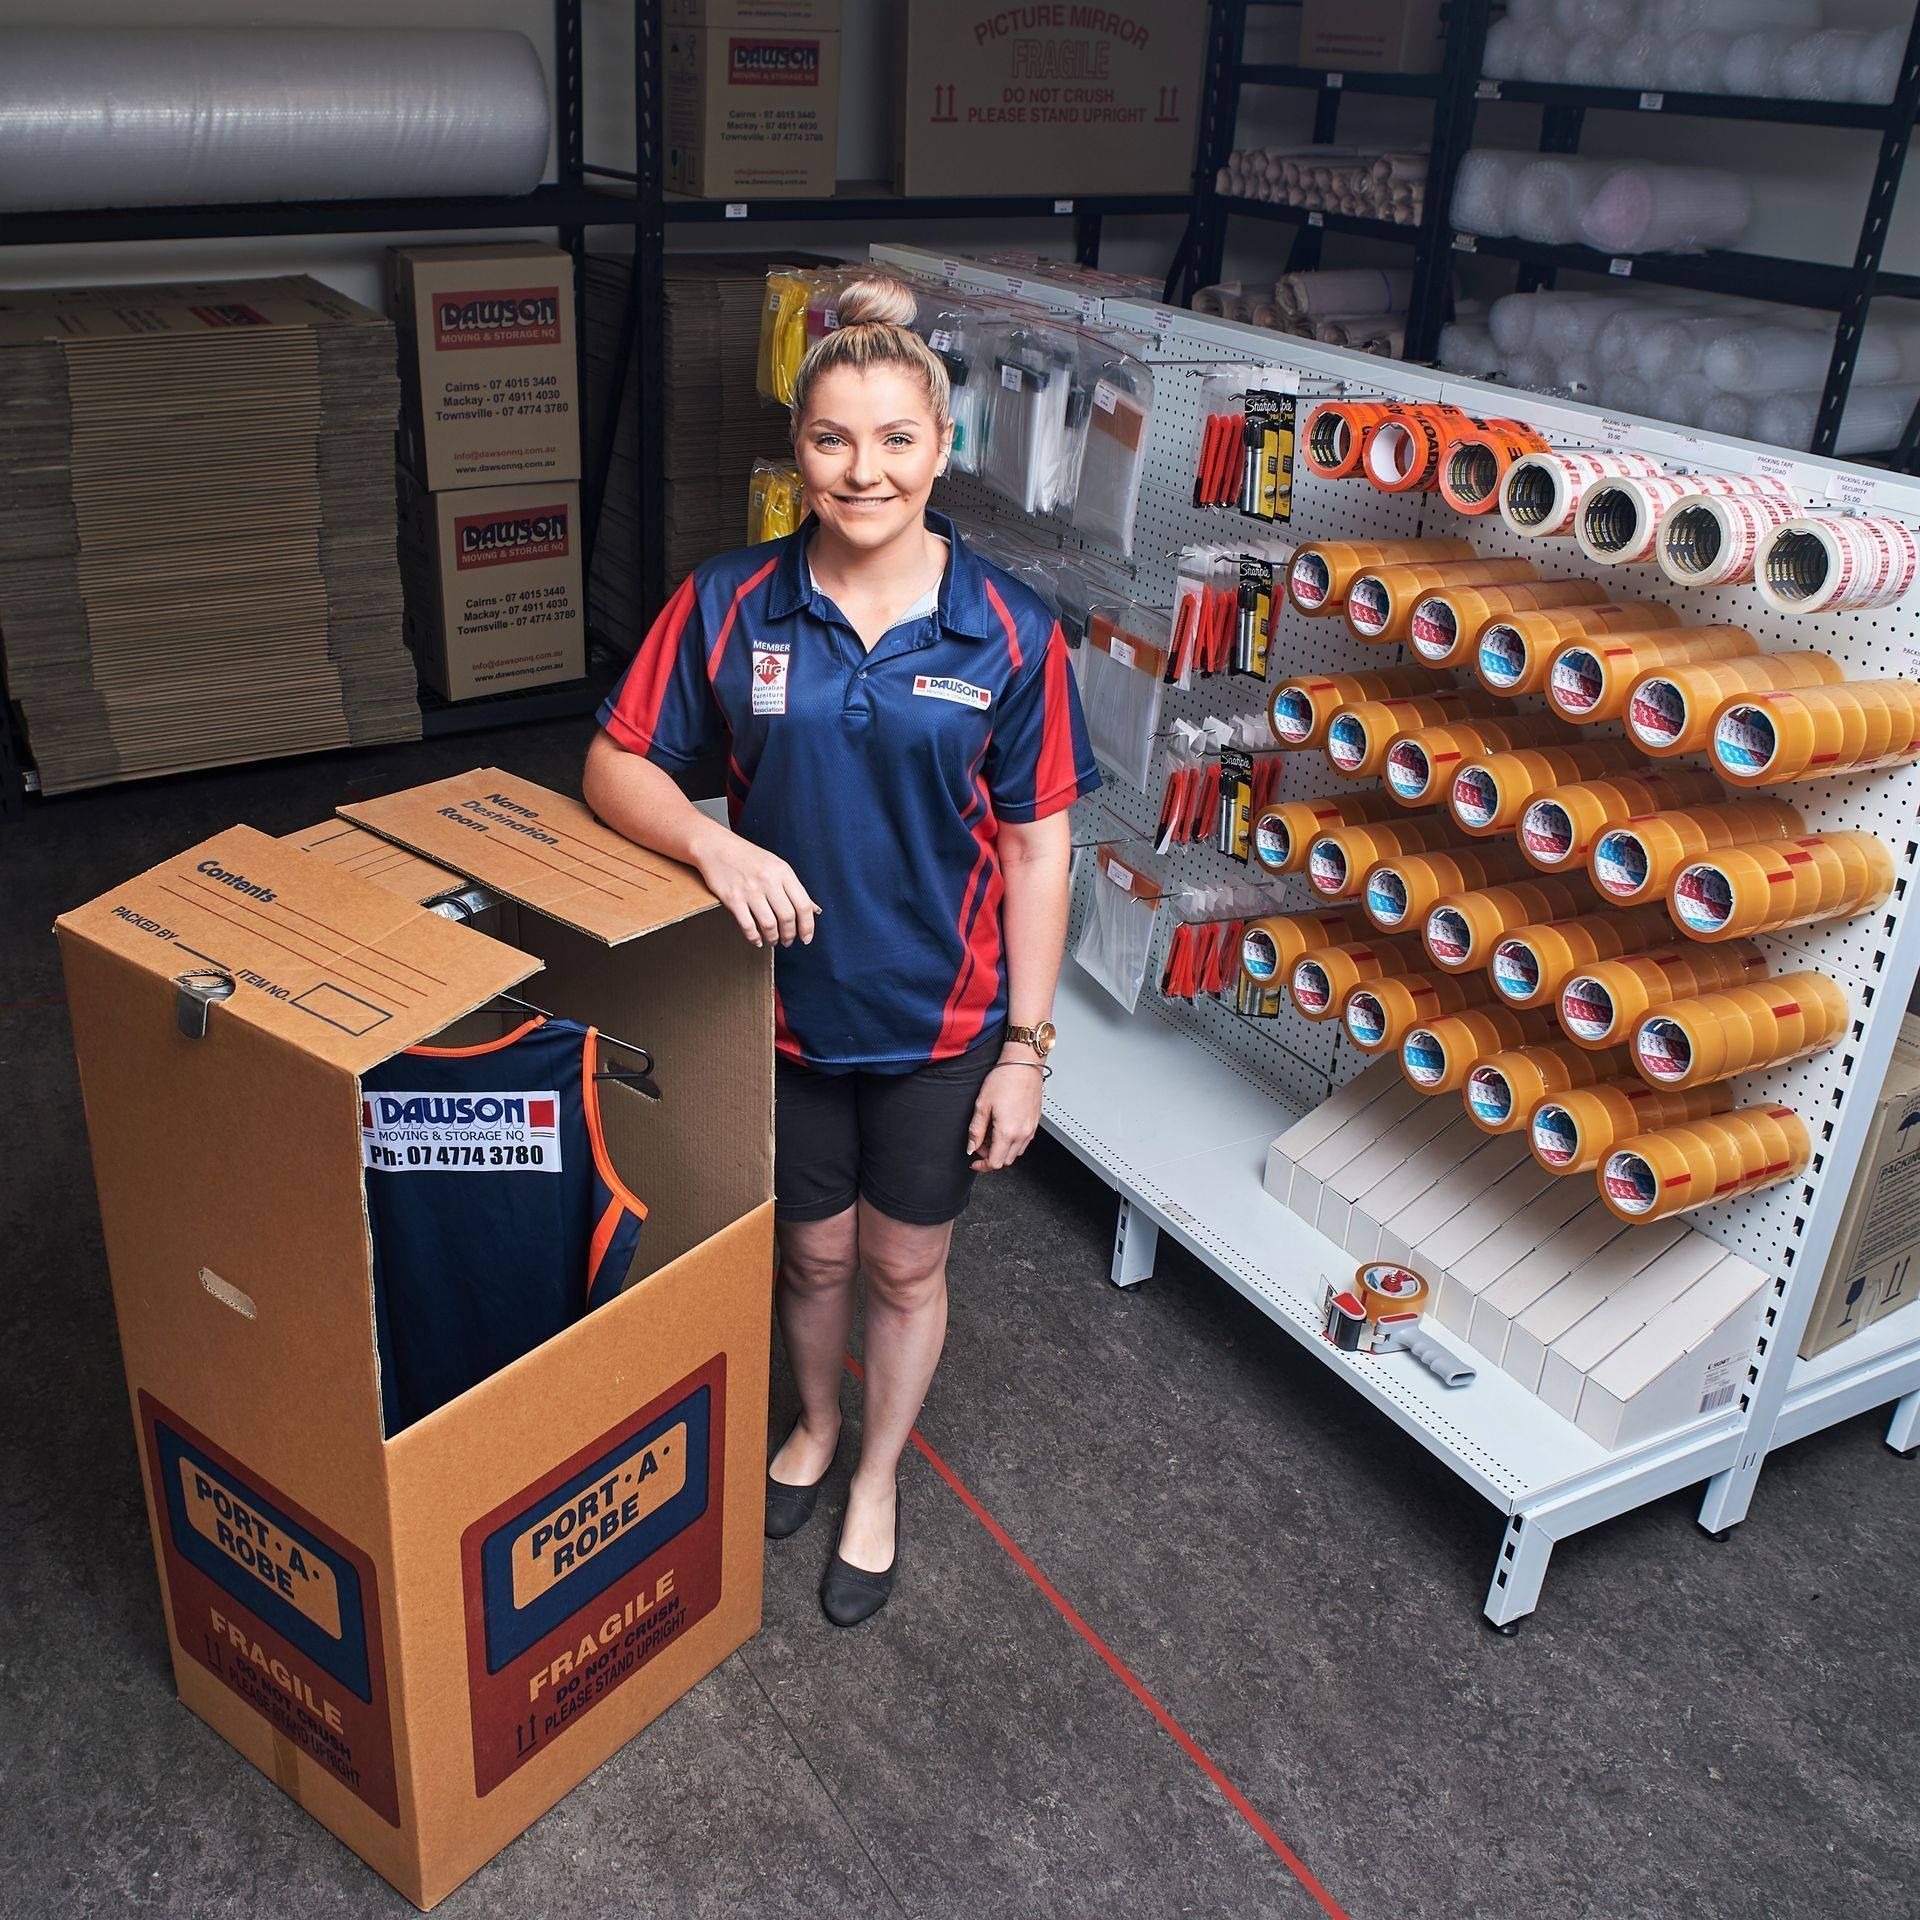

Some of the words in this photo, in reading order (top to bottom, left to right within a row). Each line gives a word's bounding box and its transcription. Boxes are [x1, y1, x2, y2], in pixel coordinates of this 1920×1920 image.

[973, 4, 1066, 47] PICTURE
[1069, 4, 1151, 51] MIRROR
[735, 46, 818, 70] DAWSON
[1011, 38, 1112, 81] FRAGILE
[1003, 87, 1026, 103] DO
[1029, 87, 1060, 103] NOT
[1063, 87, 1115, 103] CRUSH
[967, 107, 1026, 123] PLEASE
[1030, 107, 1079, 123] STAND
[1082, 107, 1148, 123] UPRIGHT
[440, 297, 557, 332] DAWSON
[441, 332, 481, 344] MOVING
[484, 332, 491, 341] &
[494, 329, 540, 341] STORAGE
[541, 327, 556, 339] NQ
[445, 380, 480, 393] Cairns
[489, 379, 502, 390] 07
[504, 378, 530, 389] 4015
[532, 376, 557, 387] 3440
[443, 394, 484, 408] Mackay
[493, 393, 505, 404] 07
[508, 391, 533, 403] 4911
[535, 389, 561, 400] 4030
[435, 407, 493, 421] Townsville
[502, 406, 514, 417] 07
[517, 404, 542, 416] 4774
[544, 402, 569, 414] 3780
[455, 458, 556, 474] www.dawsonnq.com.au
[1757, 456, 1780, 466] PACKING
[1781, 460, 1794, 468] TAPE
[1836, 474, 1861, 484] PACKING
[1862, 480, 1876, 488] TAPE
[1841, 484, 1867, 494] SECURITY
[461, 515, 567, 553] DAWSON
[462, 551, 498, 564] MOVING
[500, 550, 507, 558] &
[509, 544, 549, 557] STORAGE
[551, 542, 564, 552] NQ
[464, 608, 500, 622] Mackay
[508, 605, 520, 615] 07
[522, 602, 544, 613] 4911
[546, 598, 568, 609] 4030
[465, 596, 497, 609] Cairns
[505, 593, 517, 603] 07
[519, 589, 541, 601] 4015
[543, 586, 566, 597] 3440
[456, 620, 508, 636] Townsville
[516, 616, 527, 626] 07
[529, 613, 552, 625] 4774
[553, 609, 576, 621] 3780
[753, 640, 791, 652] MEMBER
[475, 663, 564, 682] www.dawsonnq.com.au
[754, 658, 783, 676] afra
[930, 679, 979, 698] DAWSON
[483, 793, 540, 819] Name
[436, 807, 490, 833] Room
[460, 800, 559, 846] Destination
[196, 860, 279, 903] Contents
[111, 906, 161, 934] PACKED
[154, 927, 180, 942] BY
[235, 968, 271, 992] ITEM
[264, 985, 291, 1001] NO.
[375, 1097, 525, 1130] DAWSON
[379, 1131, 429, 1141] MOVING
[432, 1131, 442, 1141] &
[445, 1131, 501, 1141] STORAGE
[506, 1130, 525, 1142] NQ
[370, 1145, 404, 1166] Ph:
[407, 1146, 432, 1165] 07
[437, 1147, 486, 1165] 4774
[490, 1145, 544, 1165] 3780
[553, 1492, 640, 1577] ROBE
[217, 1519, 295, 1600] ROBE
[529, 1568, 675, 1703] FRAGILE
[555, 1676, 580, 1704] DO
[585, 1644, 618, 1677] NOT
[624, 1596, 679, 1647] CRUSH
[210, 1606, 344, 1736] FRAGILE
[544, 1685, 593, 1735] PLEASE
[594, 1654, 635, 1693] STAND
[637, 1607, 687, 1661] UPRIGHT
[235, 1656, 257, 1682] DO
[260, 1680, 292, 1711] NOT
[297, 1706, 352, 1763] CRUSH
[310, 1732, 361, 1788] UPRIGHT
